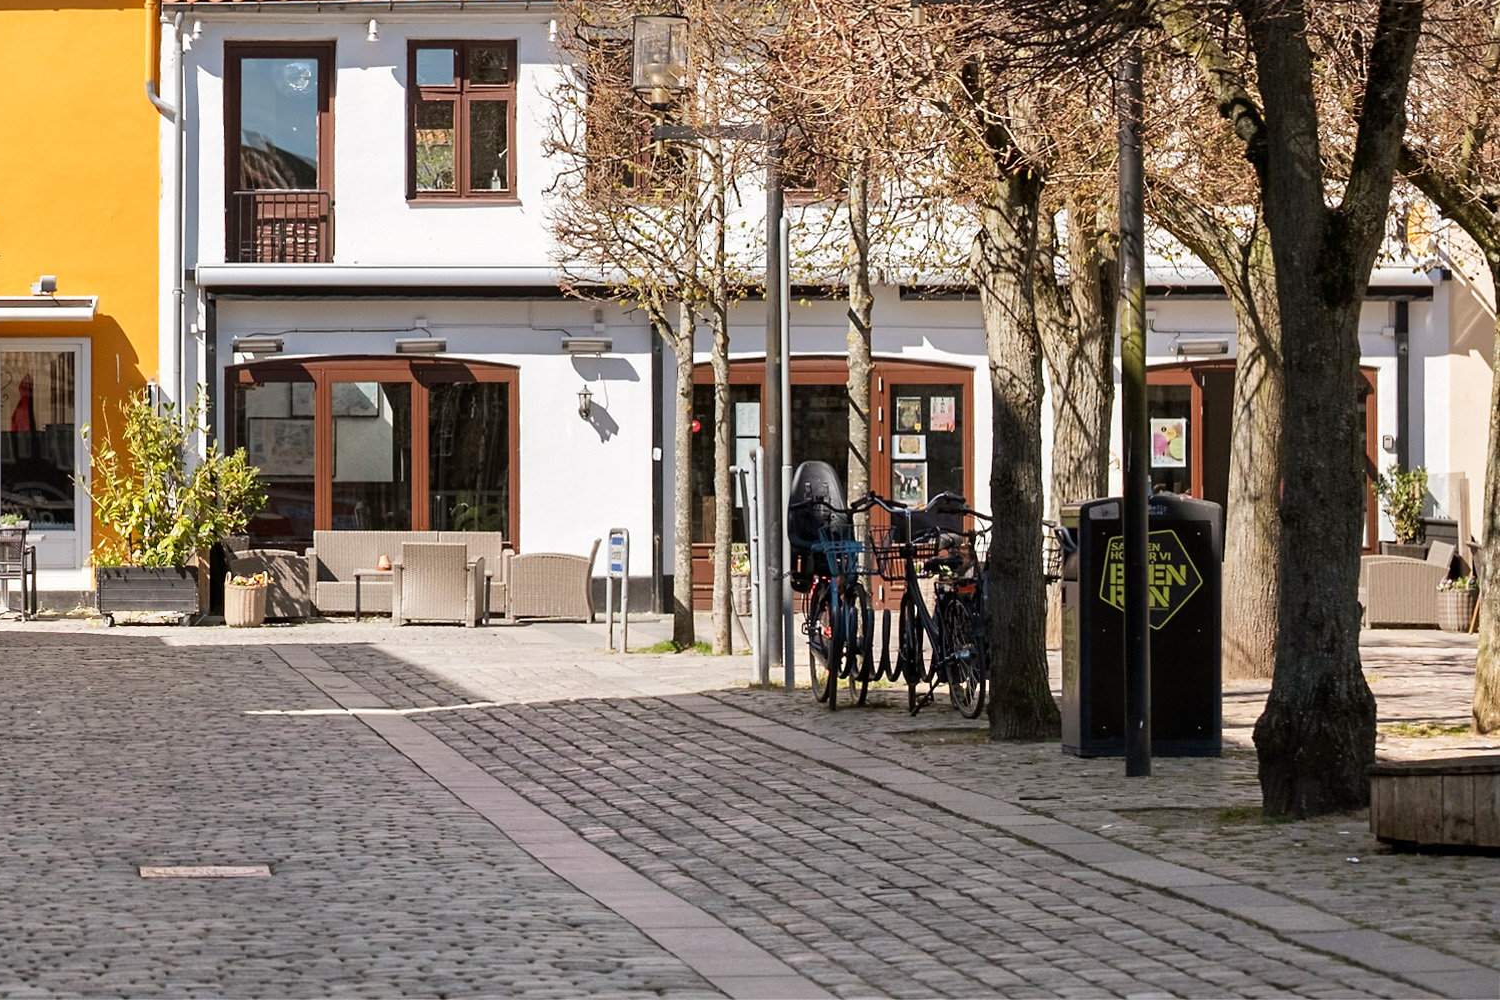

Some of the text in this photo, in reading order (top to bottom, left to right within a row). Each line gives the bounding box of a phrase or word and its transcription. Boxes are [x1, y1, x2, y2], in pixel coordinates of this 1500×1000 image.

[1110, 542, 1161, 552] SAEN
[1159, 552, 1171, 561] VI
[1109, 563, 1187, 586] BEN
[1109, 585, 1170, 608] RN
